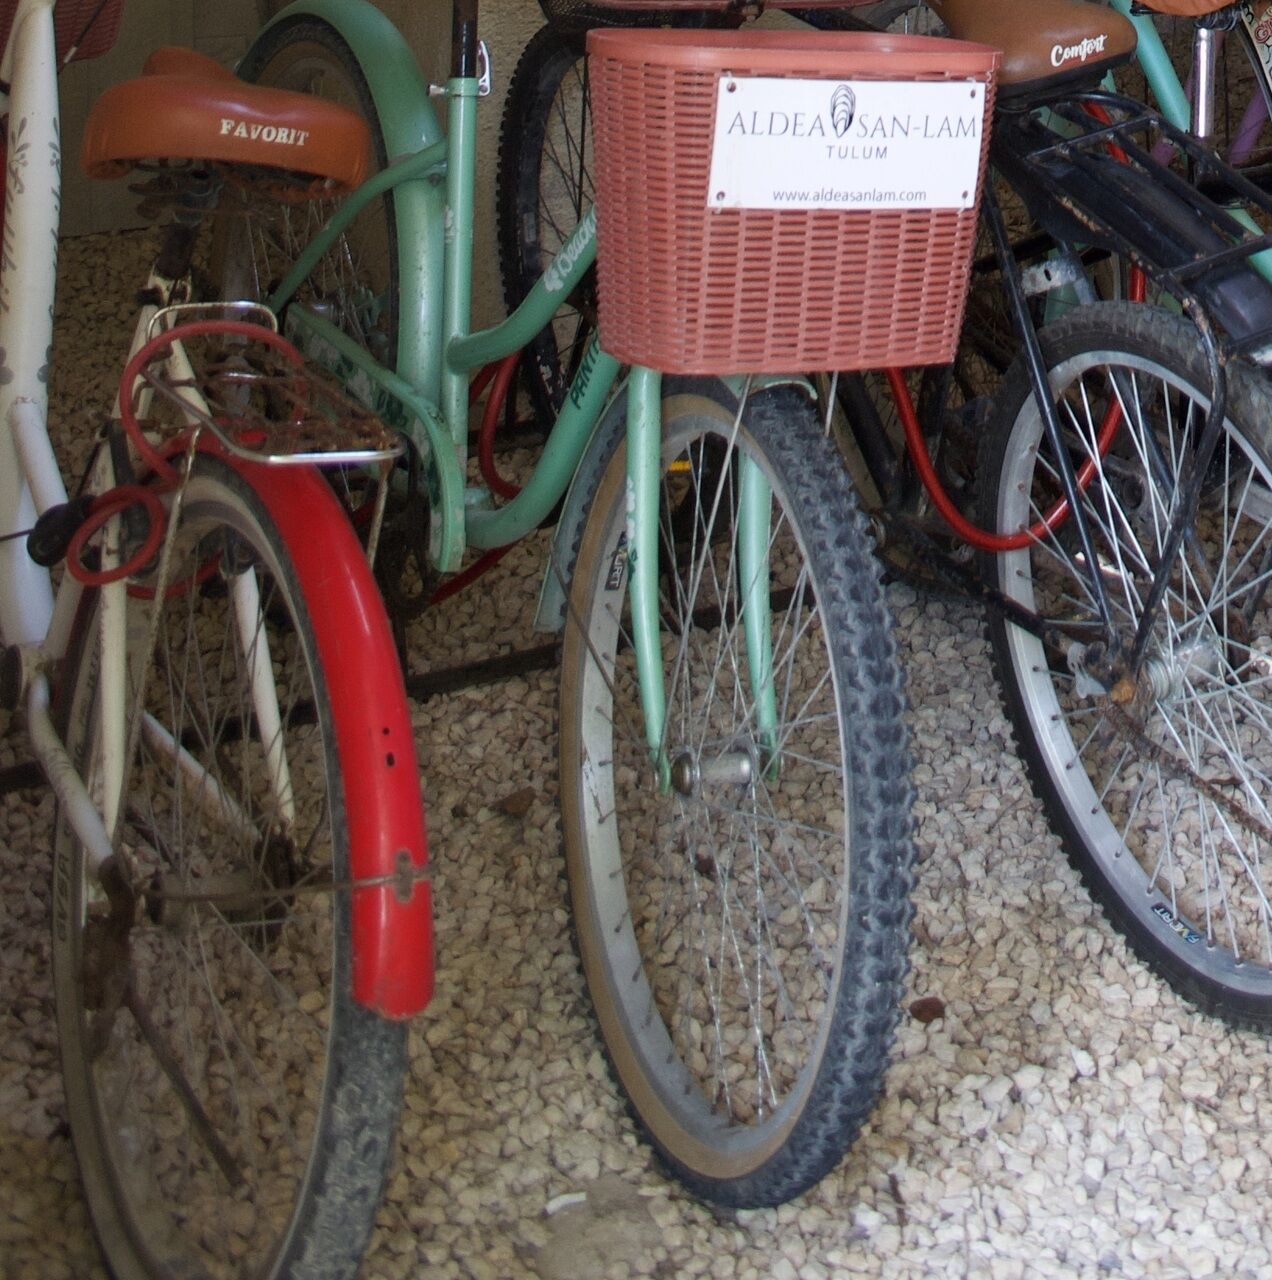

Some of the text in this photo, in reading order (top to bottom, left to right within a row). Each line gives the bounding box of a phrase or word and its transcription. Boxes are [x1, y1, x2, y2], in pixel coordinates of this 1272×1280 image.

[1050, 34, 1108, 67] Comfort
[220, 118, 310, 146] FAVORIT
[727, 111, 977, 139] ALDEA SAN-LAM
[826, 145, 888, 160] TULUM
[772, 187, 927, 203] www.aldeasanlam.com
